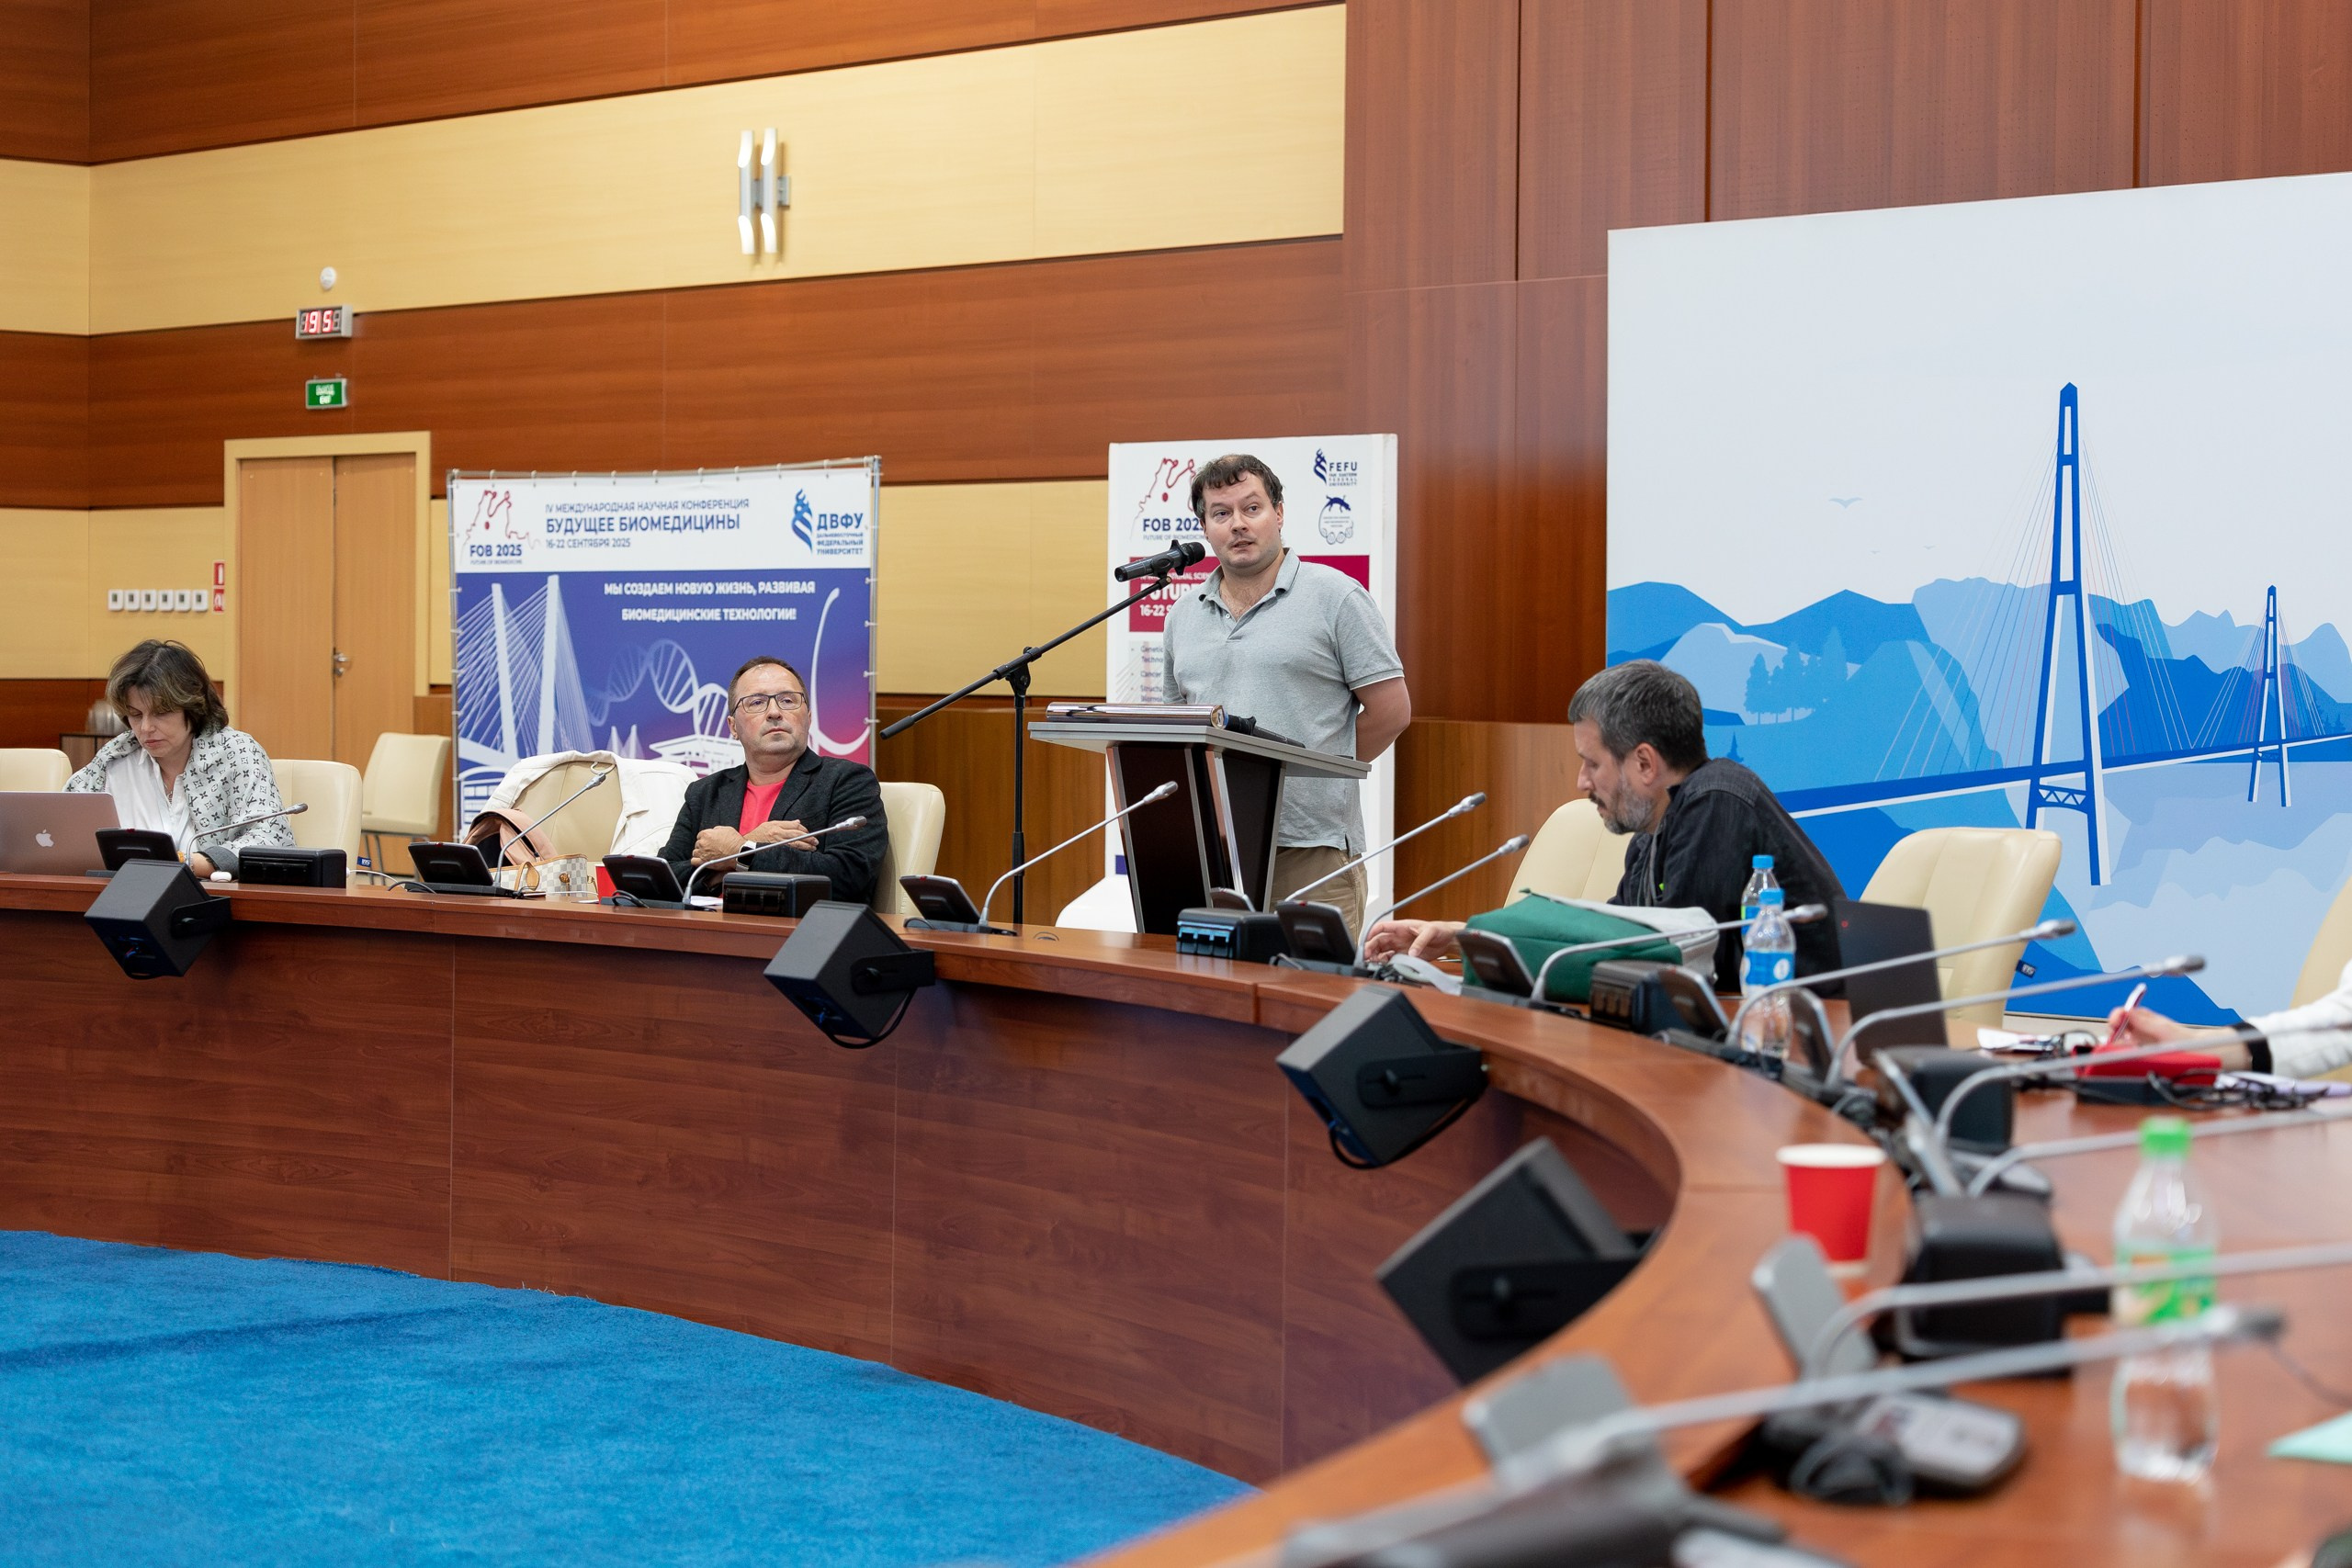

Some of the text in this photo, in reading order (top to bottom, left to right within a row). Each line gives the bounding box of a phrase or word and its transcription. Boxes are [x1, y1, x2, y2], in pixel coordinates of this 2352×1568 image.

[1329, 462, 1357, 471] FEFU
[556, 502, 635, 513] МЕЖДУНАРОДНАЯ
[638, 501, 678, 511] НАУЧНАЯ
[681, 499, 749, 510] КОНФЕРЕНЦИЯ
[547, 514, 740, 536] БУДУЩЕЕ БИОМЕДИЦИНЫ
[817, 513, 864, 531] ДВФУ
[1143, 519, 1170, 531] FOB
[567, 538, 609, 548] СЕНТЯБРЯ
[612, 537, 631, 547] 2025
[470, 545, 522, 557] FOB 2025
[605, 581, 815, 596] МЫ СОЗДАЕМ НОВУЮ ЖИЗНЬ, РАЗВИВАЯ
[622, 608, 797, 622] БИОМЕДИЦИНСКИЕ ТЕХНОЛОГИИ!
[1140, 604, 1165, 616] 16-22
